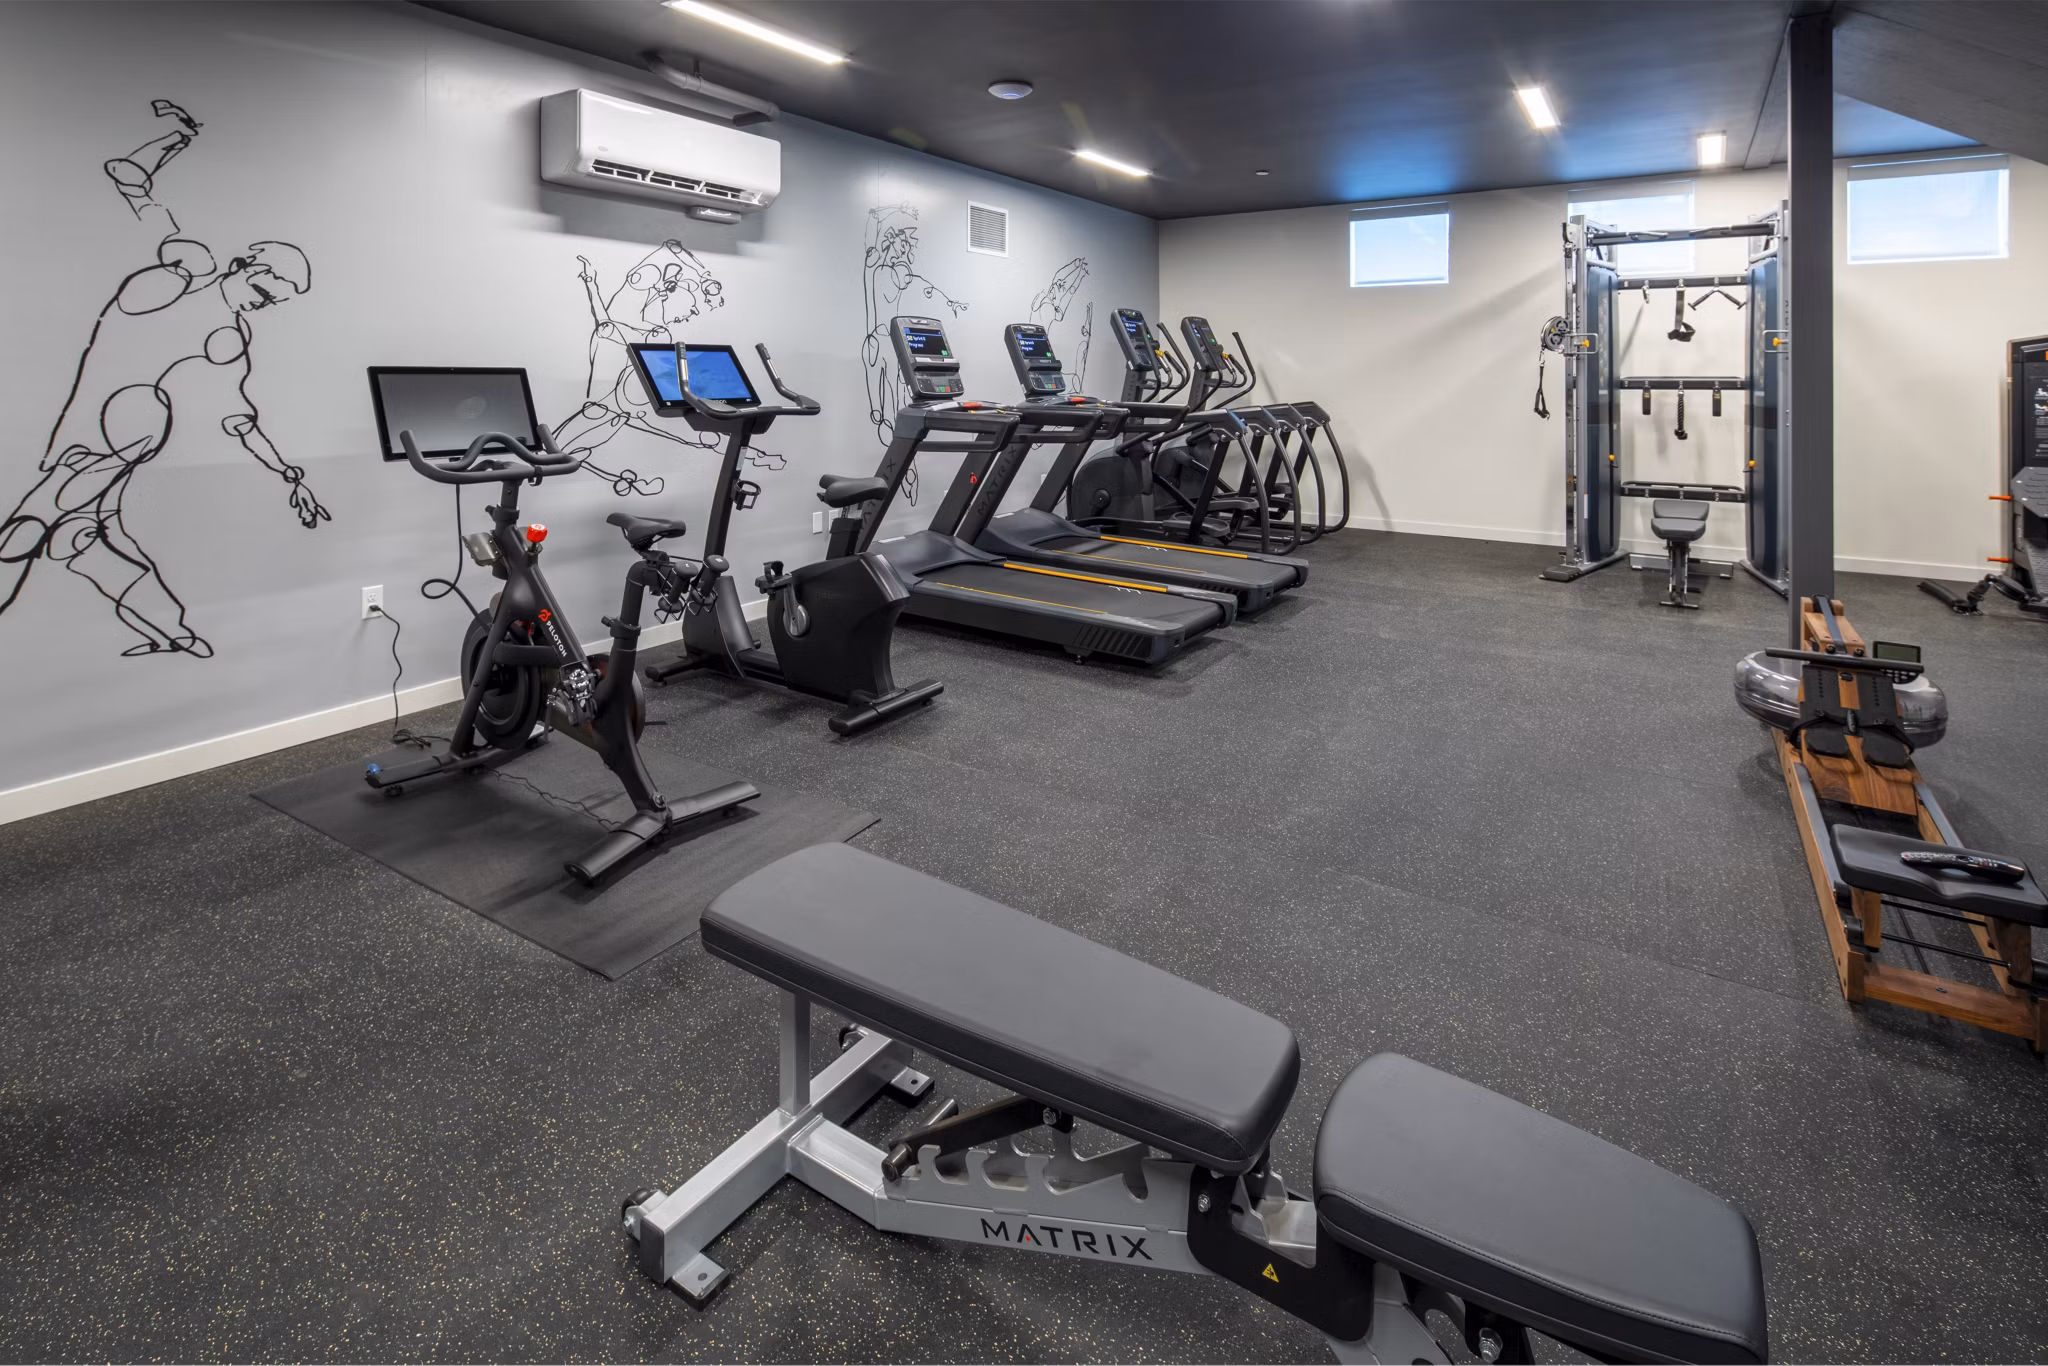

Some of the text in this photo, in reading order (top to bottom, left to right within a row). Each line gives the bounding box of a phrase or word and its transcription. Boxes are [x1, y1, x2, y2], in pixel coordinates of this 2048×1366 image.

[977, 445, 1017, 516] MATRIX
[546, 620, 568, 658] PELOTON
[979, 1217, 1154, 1262] MATRIX
